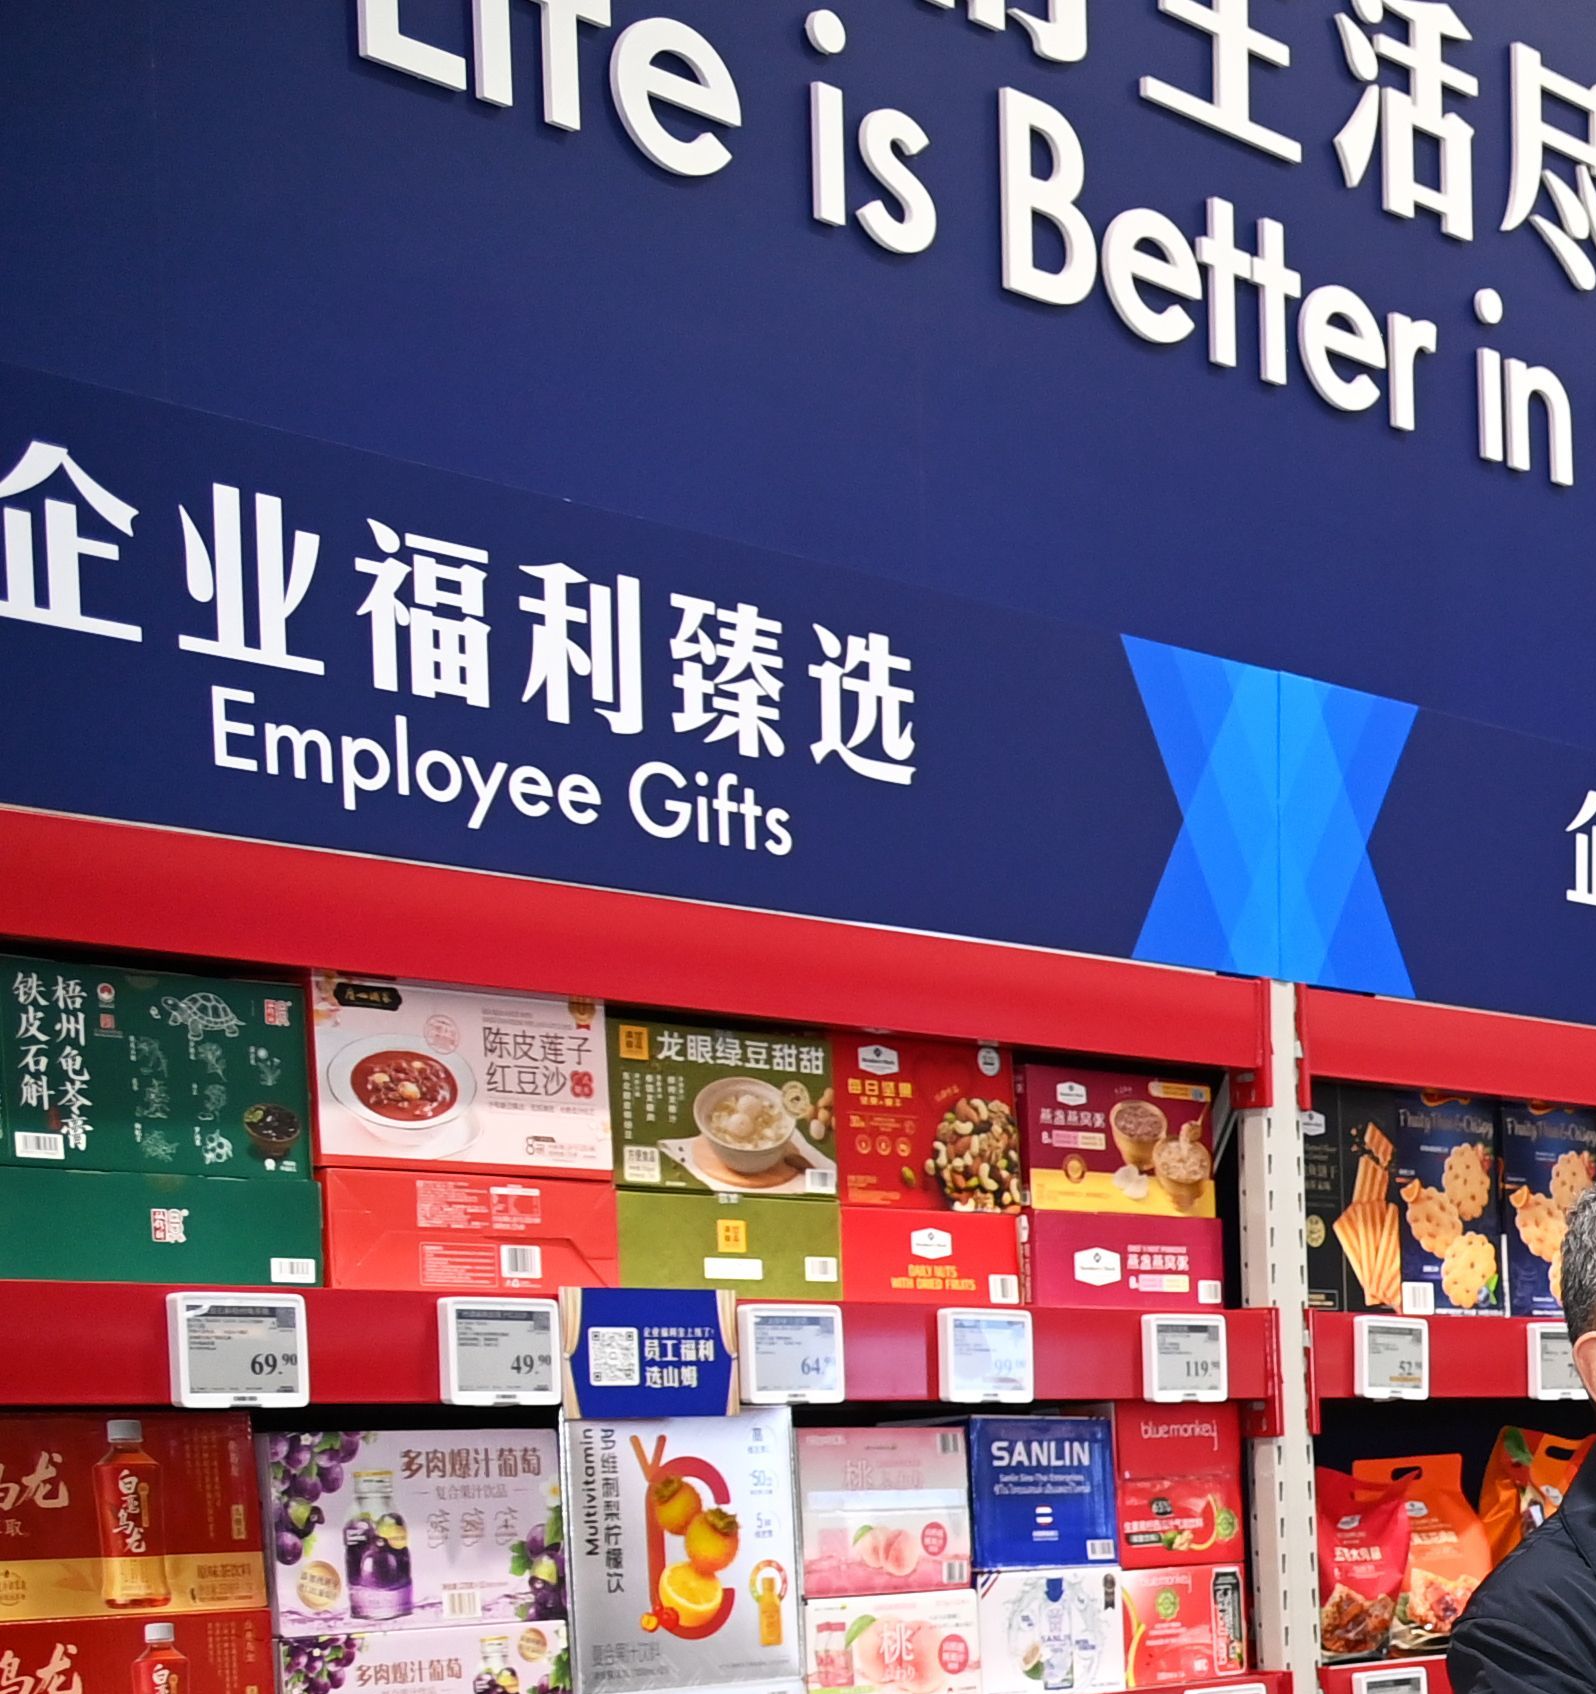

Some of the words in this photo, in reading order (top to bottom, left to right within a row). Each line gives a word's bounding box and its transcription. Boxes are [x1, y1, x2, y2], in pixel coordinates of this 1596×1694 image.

[804, 9, 937, 254] is
[1000, 86, 1437, 431] Better
[1474, 289, 1573, 487] in
[0, 440, 917, 786] 企业福利臻选
[211, 685, 601, 829] Employee
[628, 760, 793, 857] Gifts
[12, 972, 54, 1110] 铁皮石斛
[52, 974, 93, 1151] 梧州龟苓膏
[482, 1026, 592, 1065] 陈皮莲子
[657, 1031, 824, 1074] 龙眼绿豆甜甜
[486, 1062, 567, 1097] 红豆沙
[644, 1339, 714, 1362] 员工福利
[645, 1366, 697, 1388] 选山姆
[401, 1447, 541, 1479] 多肉爆汁葡萄
[990, 1440, 1090, 1467] SANLIN
[113, 1469, 146, 1553] 白毫乌龙
[579, 1428, 599, 1555] Multivitamin
[357, 1658, 462, 1687] 多肉爆汁葡萄
